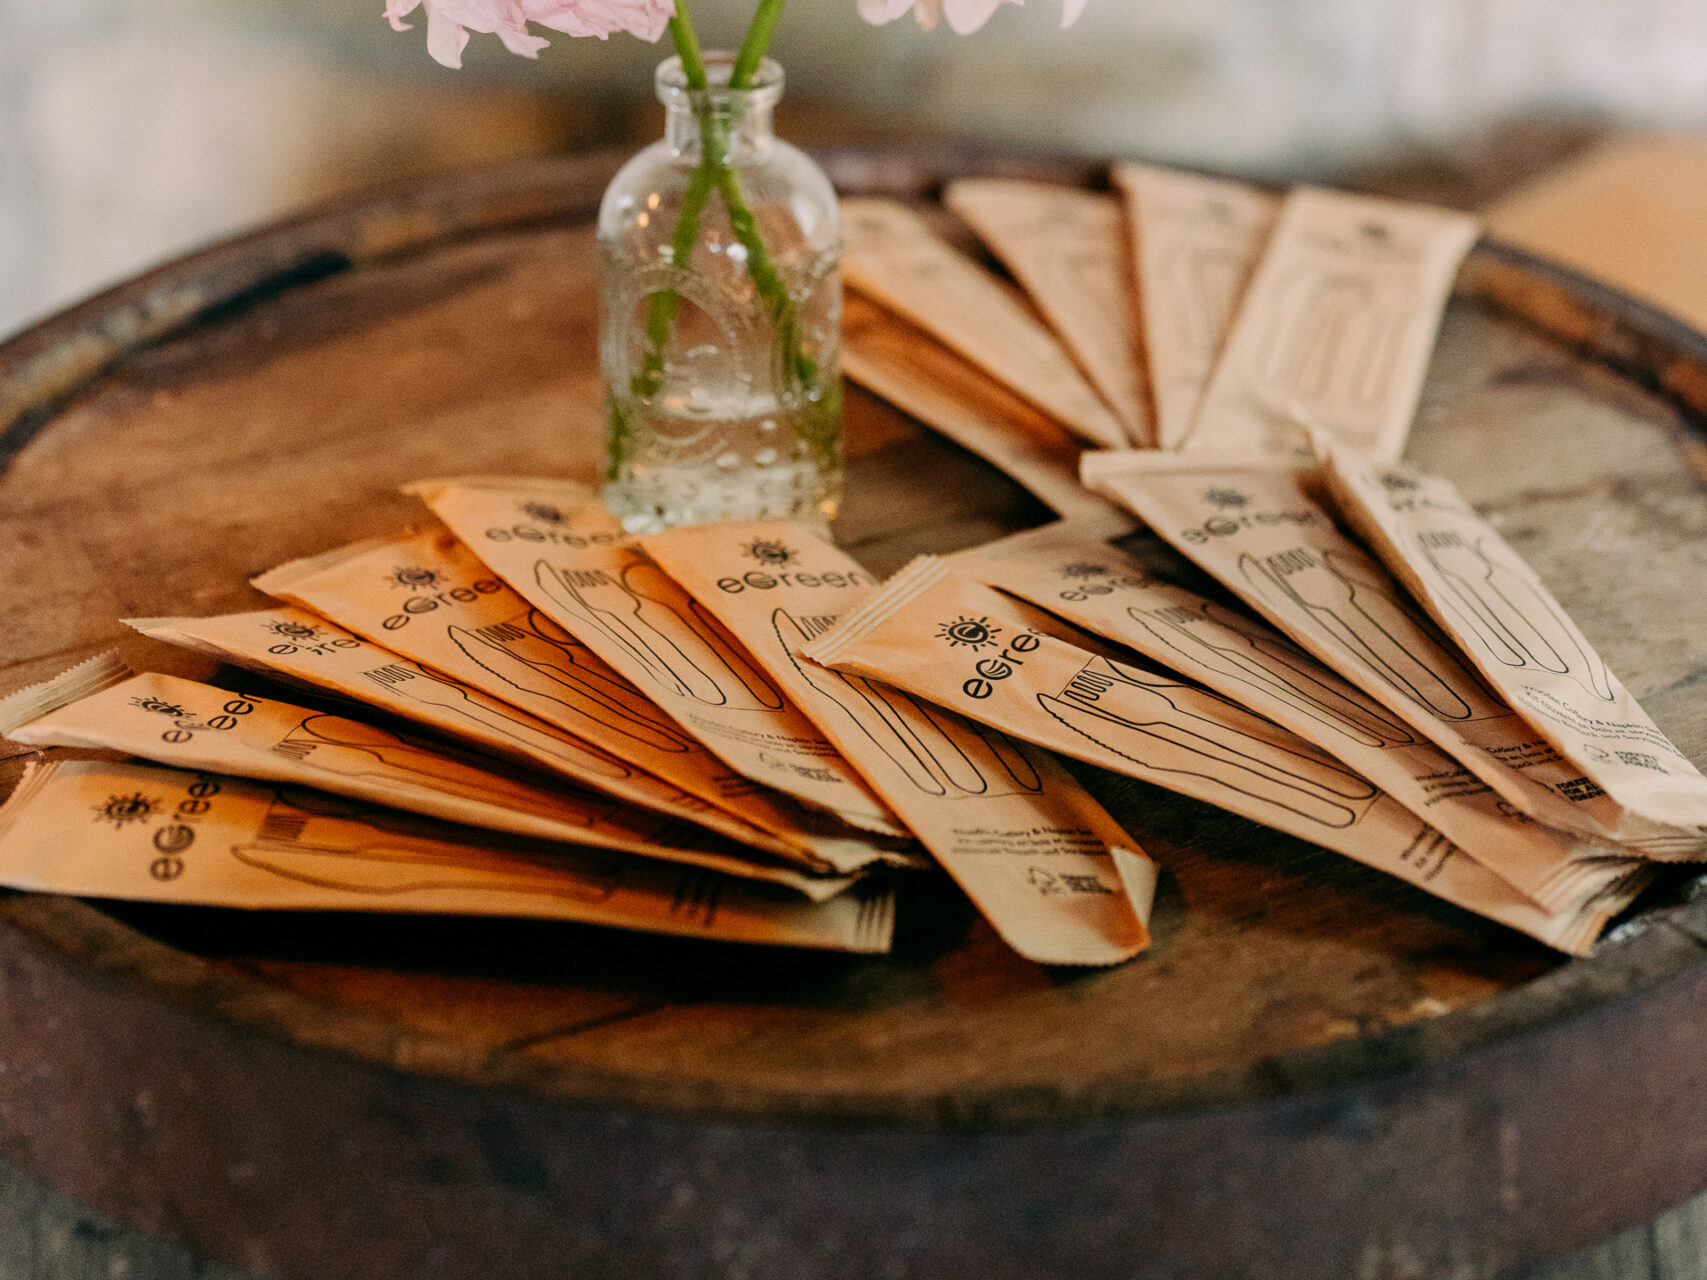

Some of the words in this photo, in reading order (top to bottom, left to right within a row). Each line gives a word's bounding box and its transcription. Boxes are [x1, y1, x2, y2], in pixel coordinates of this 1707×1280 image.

[382, 579, 502, 630] eGree
[962, 627, 1041, 699] eGre
[149, 780, 220, 882] eGree
